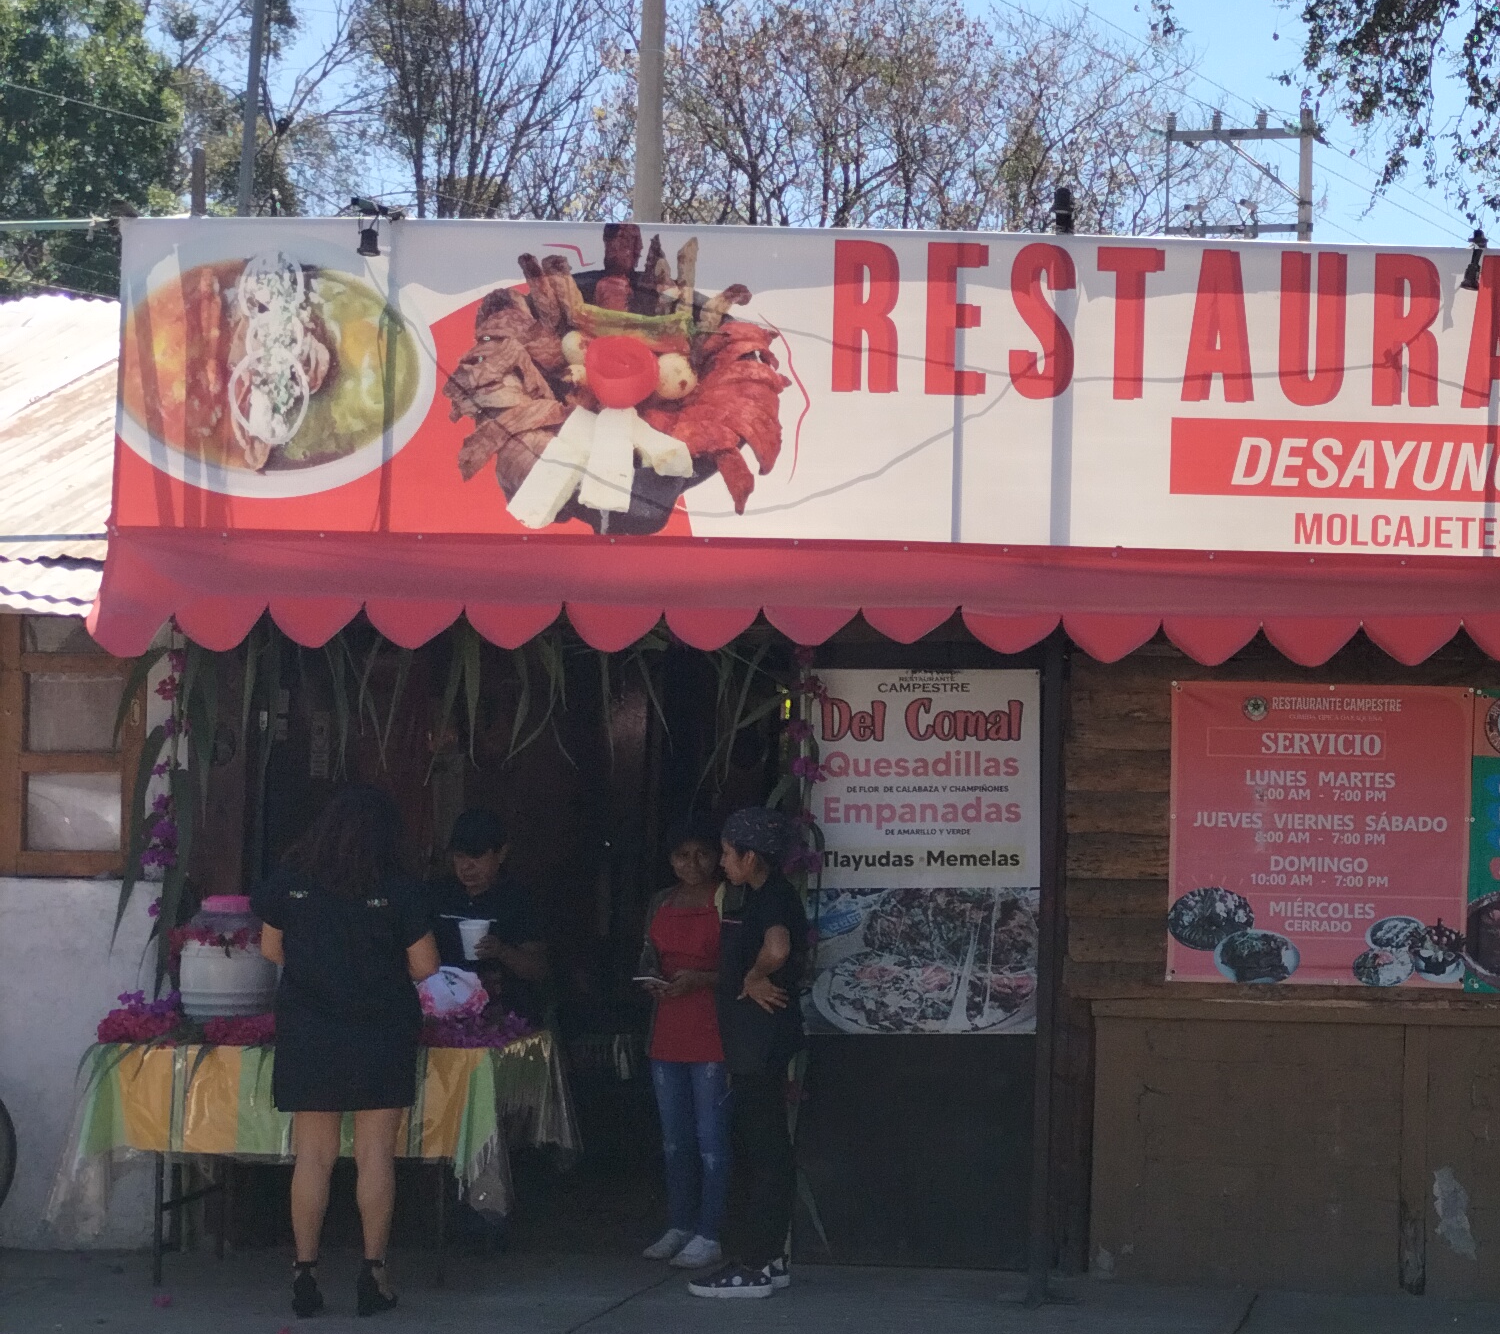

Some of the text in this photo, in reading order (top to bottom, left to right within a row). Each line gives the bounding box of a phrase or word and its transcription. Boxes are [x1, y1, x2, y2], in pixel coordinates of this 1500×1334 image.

[878, 683, 970, 693] CAMPESTRE
[1272, 696, 1341, 711] RESTAURANTE
[1343, 698, 1402, 713] CAMPESTRE
[820, 697, 1023, 742] Del Comal
[1261, 732, 1382, 756] SERVICIO
[824, 750, 1020, 777] Quesadillas
[1246, 770, 1396, 788] LUNES MARTES
[859, 785, 879, 793] FLOR
[896, 785, 940, 793] CALABAZA
[1288, 789, 1310, 801] AM
[1332, 789, 1361, 801] 7:00
[1365, 790, 1386, 802] PM
[824, 796, 1022, 830] Empanadas
[1193, 812, 1448, 833] JUEVES VIERNES SÁBADO
[897, 828, 937, 836] AMARILLO
[1255, 832, 1283, 843] 8:00
[1287, 832, 1310, 843] AM
[1332, 832, 1360, 844] 7:00
[1365, 833, 1385, 845] PM
[823, 850, 1020, 871] Tlayudas Memelas
[1270, 855, 1368, 873] DOMINGO
[1251, 873, 1286, 885] 10:00
[1290, 874, 1313, 886] AM
[1335, 875, 1363, 887] 7:00
[1368, 876, 1388, 888] PM
[1269, 898, 1375, 919] MIÉRCOLES
[1284, 919, 1352, 933] CERRADO
